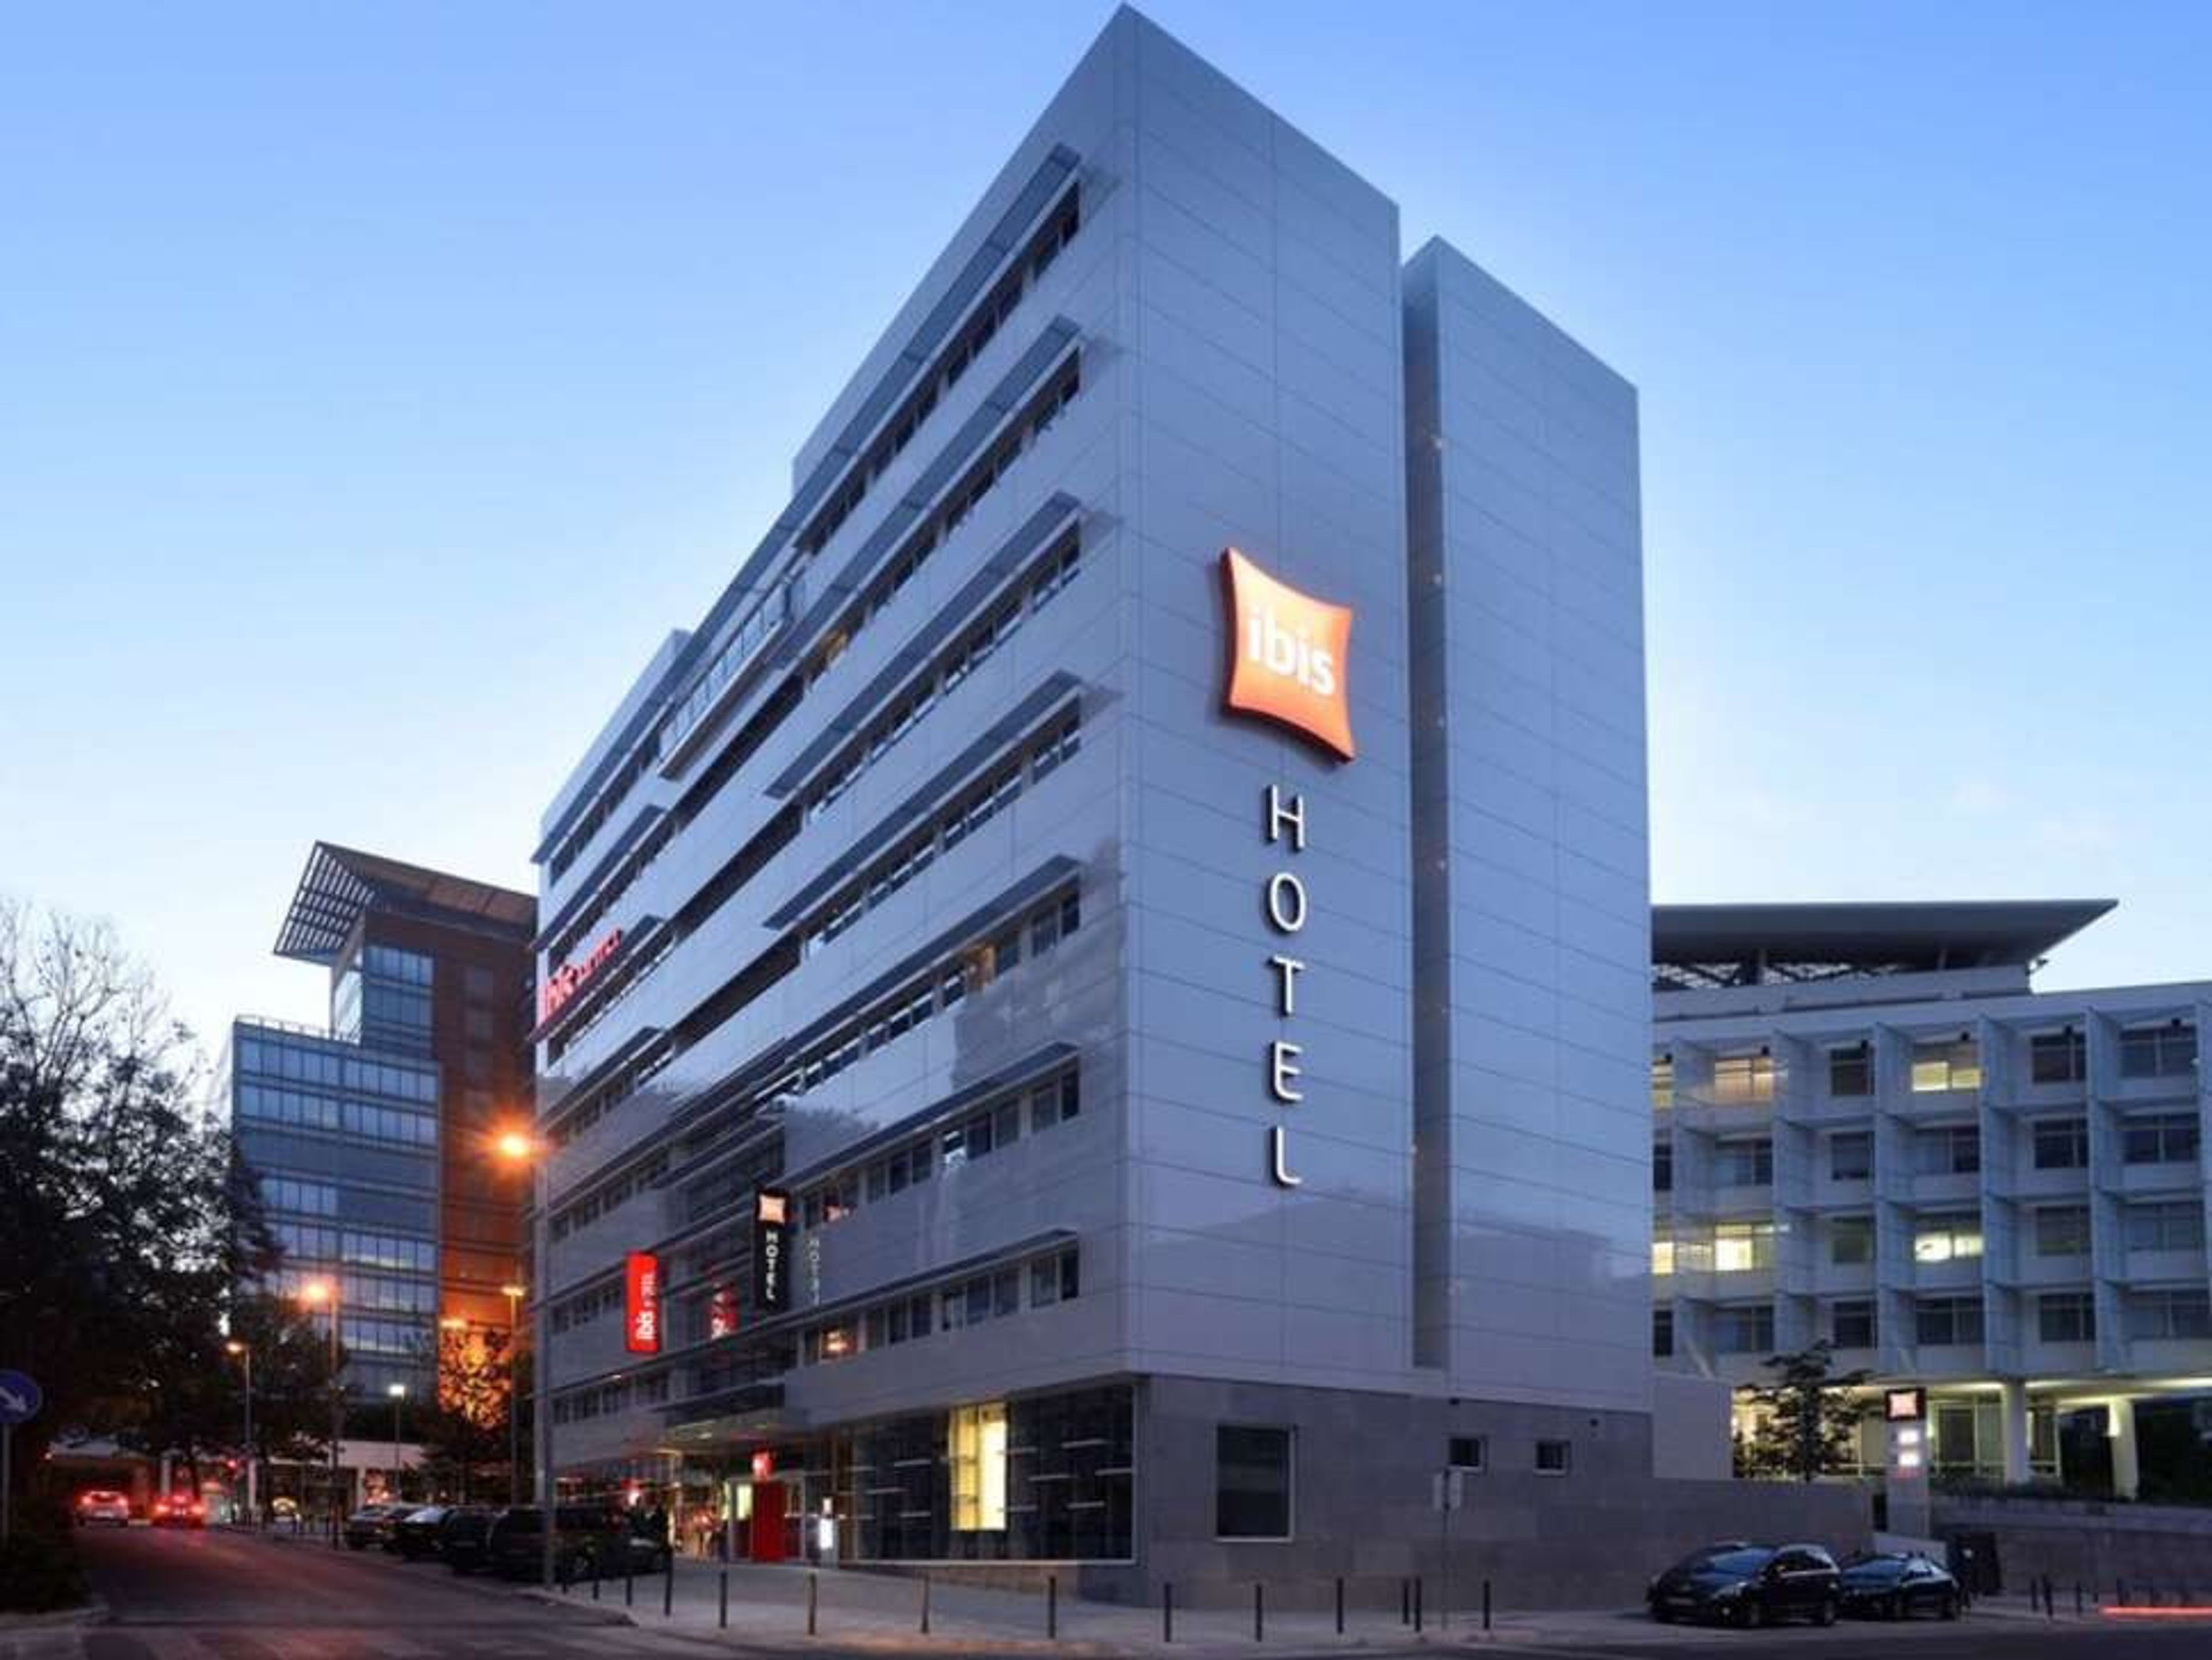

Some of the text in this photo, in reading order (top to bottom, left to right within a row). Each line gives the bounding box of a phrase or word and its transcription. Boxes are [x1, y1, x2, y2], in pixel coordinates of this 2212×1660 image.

[1248, 604, 1336, 697] ibis
[1269, 784, 1307, 1185] HOTEL
[766, 1229, 778, 1301] HOTEL
